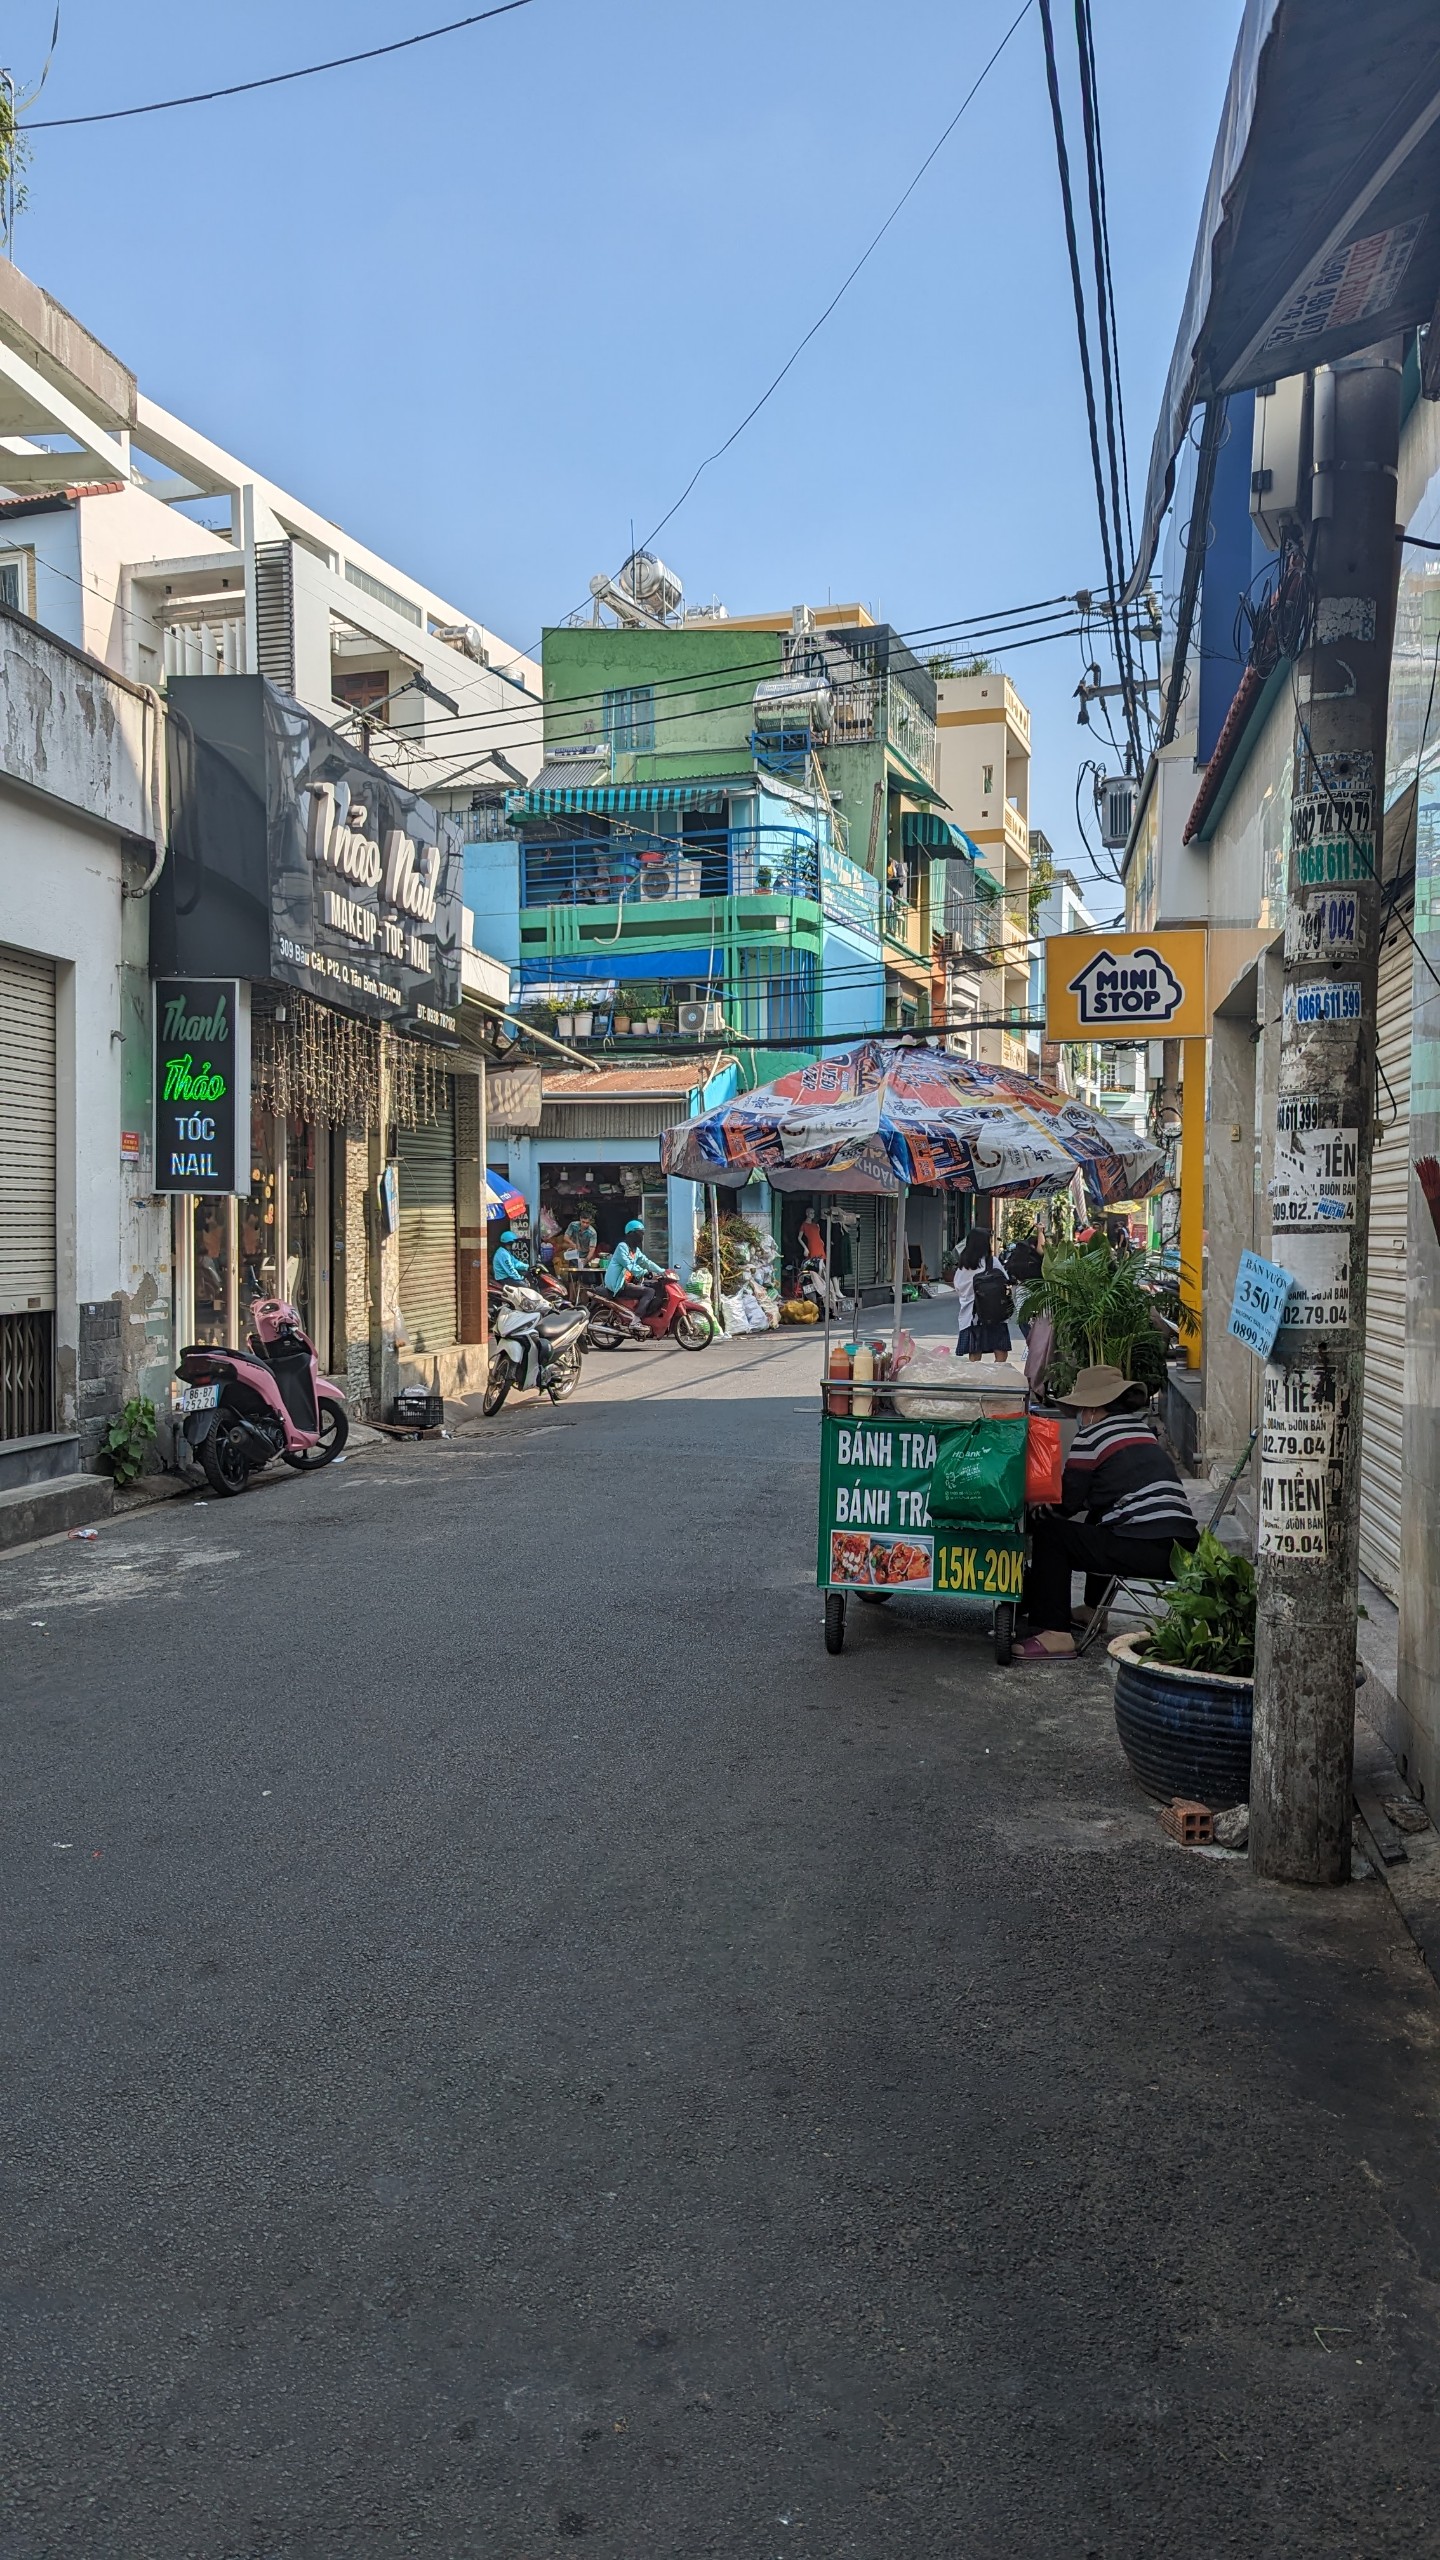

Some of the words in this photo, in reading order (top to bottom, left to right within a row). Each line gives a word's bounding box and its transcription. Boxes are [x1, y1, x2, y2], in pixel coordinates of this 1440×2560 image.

[308, 782, 382, 888] Thảo
[381, 829, 441, 923] Nail
[279, 937, 294, 959] 309
[410, 935, 432, 974] NAIL
[1096, 969, 1157, 991] MINI
[163, 994, 229, 1042] Thanh
[1094, 990, 1161, 1013] STOP
[163, 1053, 226, 1101] Thảo
[175, 1110, 216, 1141] TÓC
[171, 1152, 219, 1176] NAIL
[1240, 1280, 1270, 1314] 350
[184, 1397, 215, 1411] 252.20
[189, 1386, 213, 1400] 86-B7
[837, 1421, 893, 1467] BÁNH
[835, 1478, 890, 1525] BÁNH
[1278, 1467, 1321, 1511] TIỀN
[938, 1546, 1024, 1594] 15K-20K
